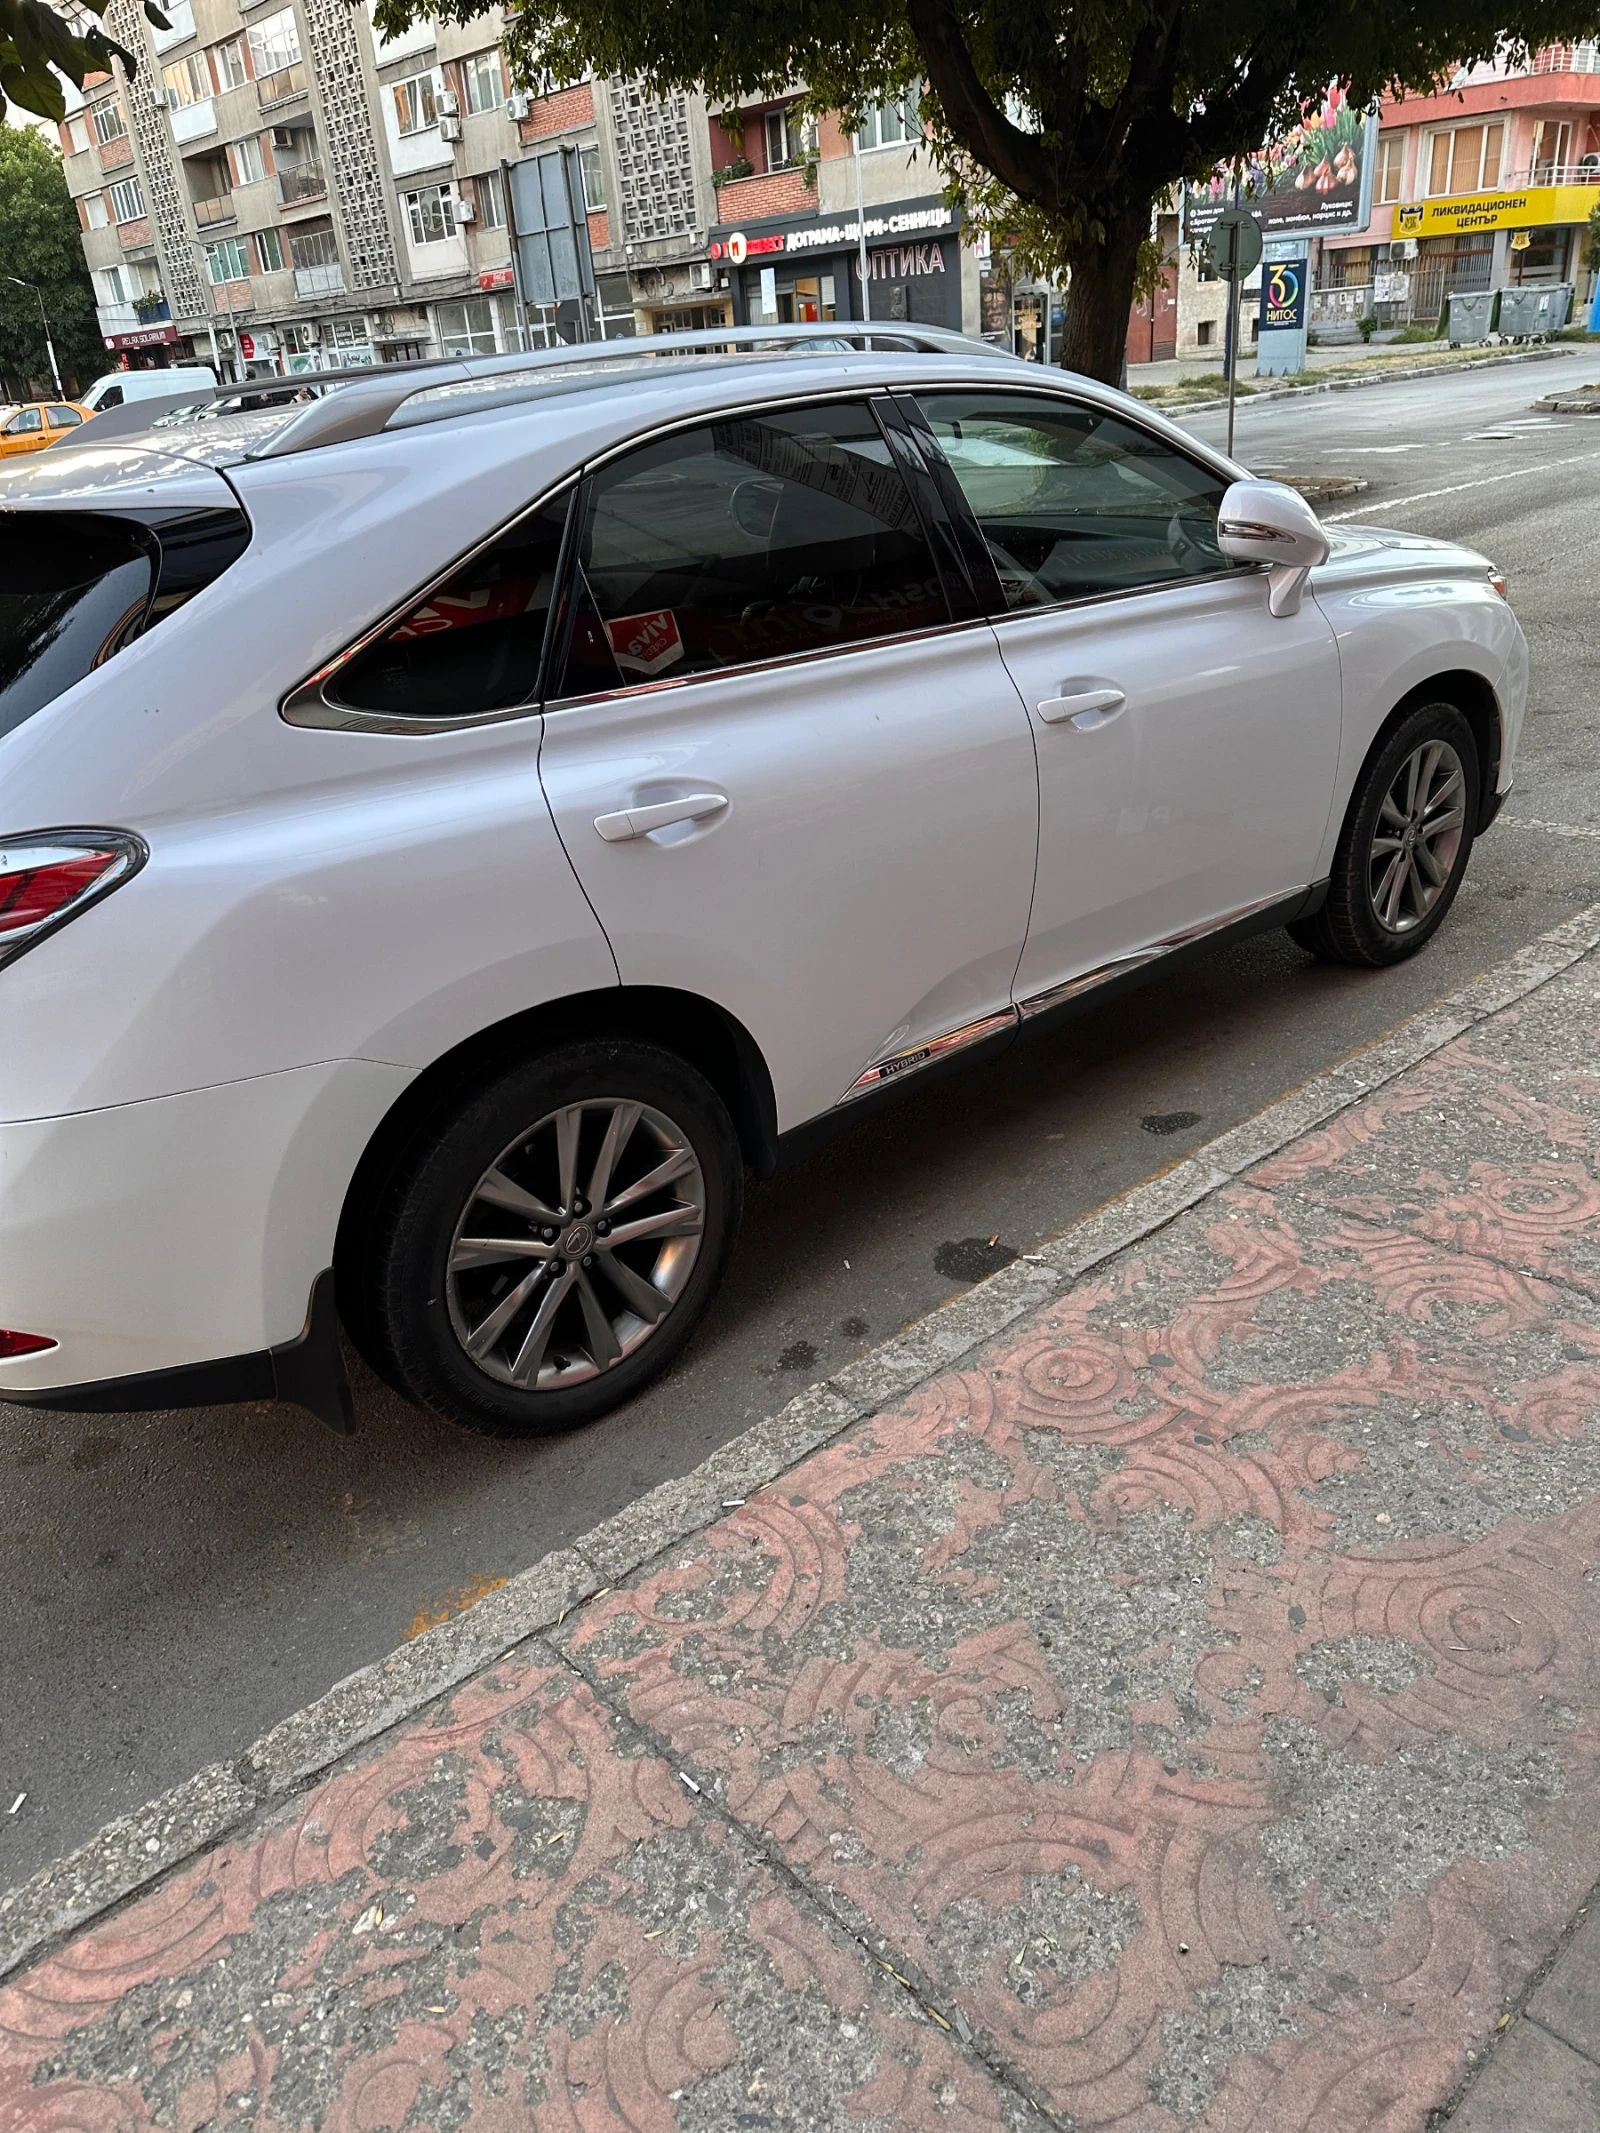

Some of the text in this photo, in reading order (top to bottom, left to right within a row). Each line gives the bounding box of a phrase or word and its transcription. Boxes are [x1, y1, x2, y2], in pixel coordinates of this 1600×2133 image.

[1432, 198, 1526, 217] ЛИКВИДАЦИОНЕН
[786, 226, 840, 252] ДОГРАМА
[889, 207, 952, 233] СЕННИЦИ
[1456, 214, 1498, 228] ЦЕНТЪР
[855, 243, 946, 281] ОПТИКА
[1266, 309, 1297, 321] НИТОС
[121, 331, 167, 346] RELAX SOLARIUM
[885, 1051, 926, 1075] HYBRID
